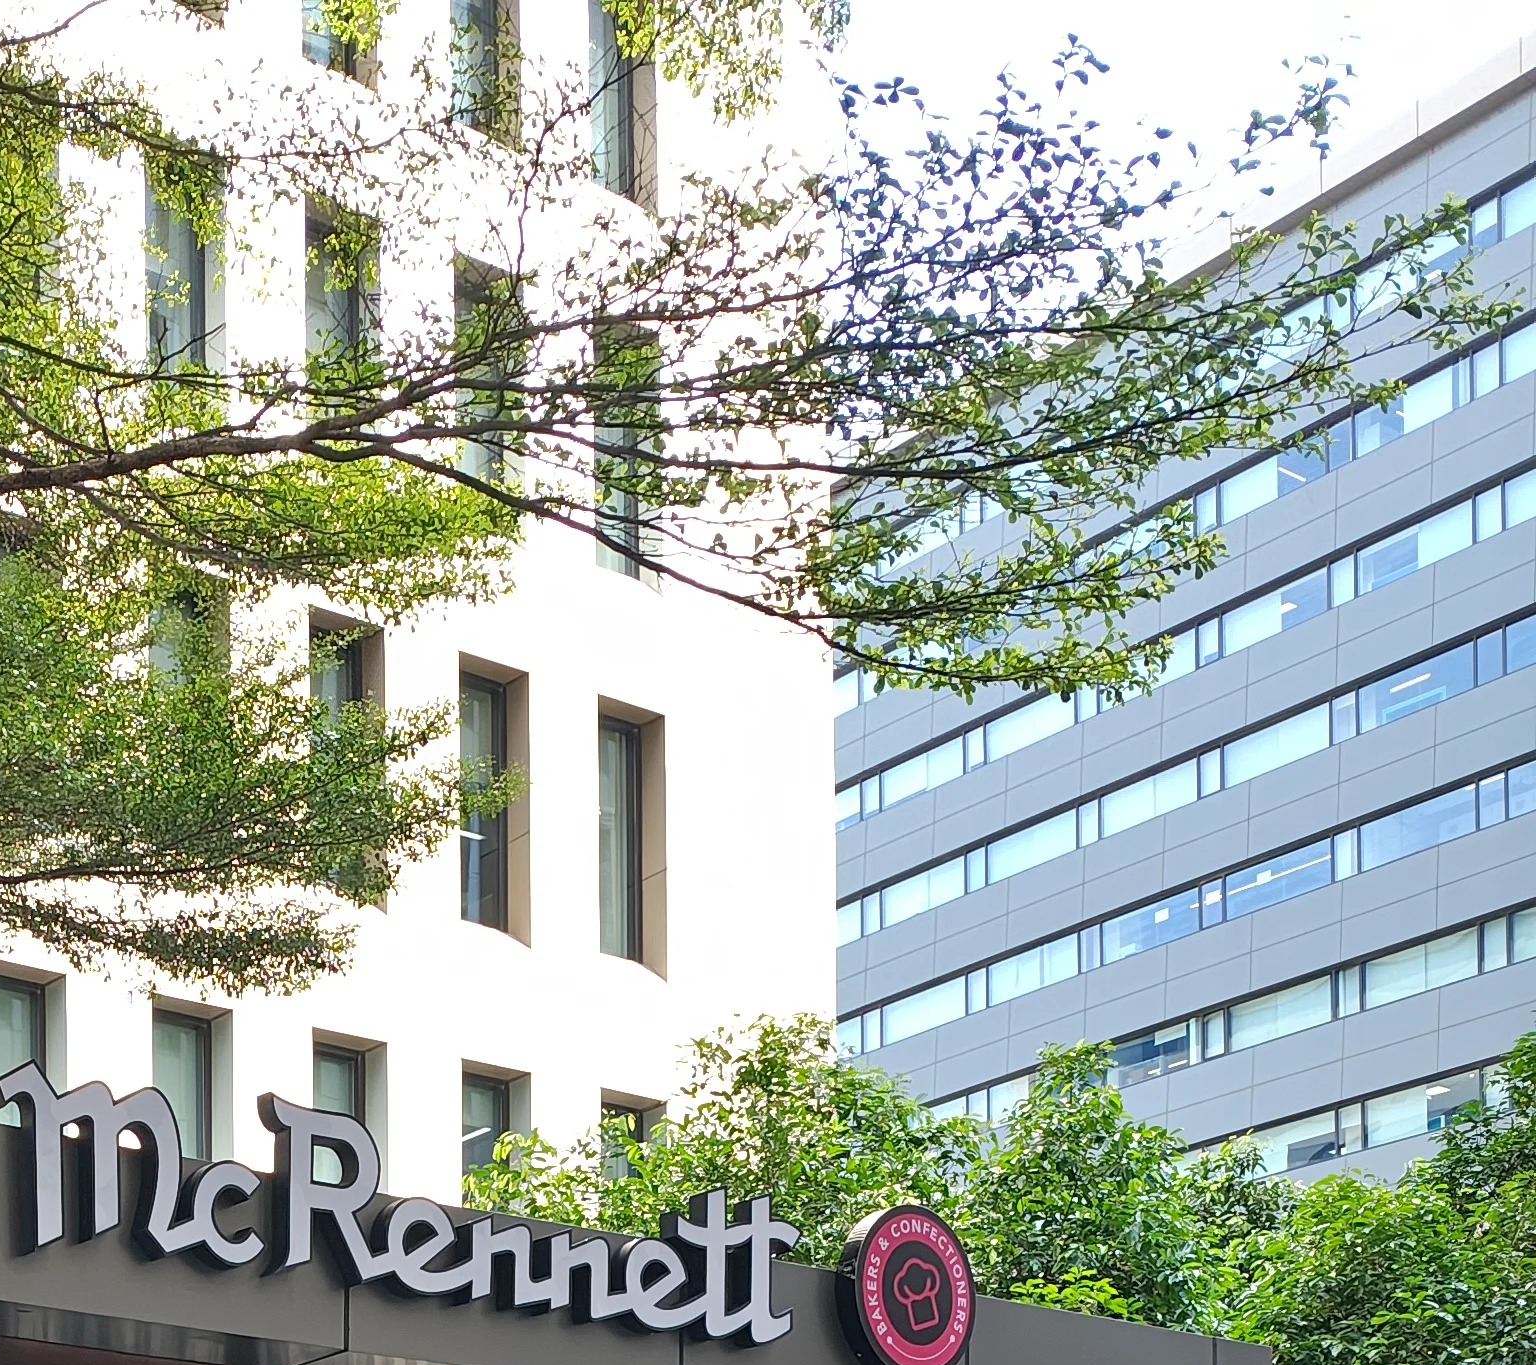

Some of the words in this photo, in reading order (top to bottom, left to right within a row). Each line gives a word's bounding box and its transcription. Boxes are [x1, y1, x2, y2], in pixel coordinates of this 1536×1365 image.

[867, 1253, 888, 1336] BAKERS
[878, 1236, 890, 1251] &
[890, 1219, 967, 1334] CONFECTIONERS
